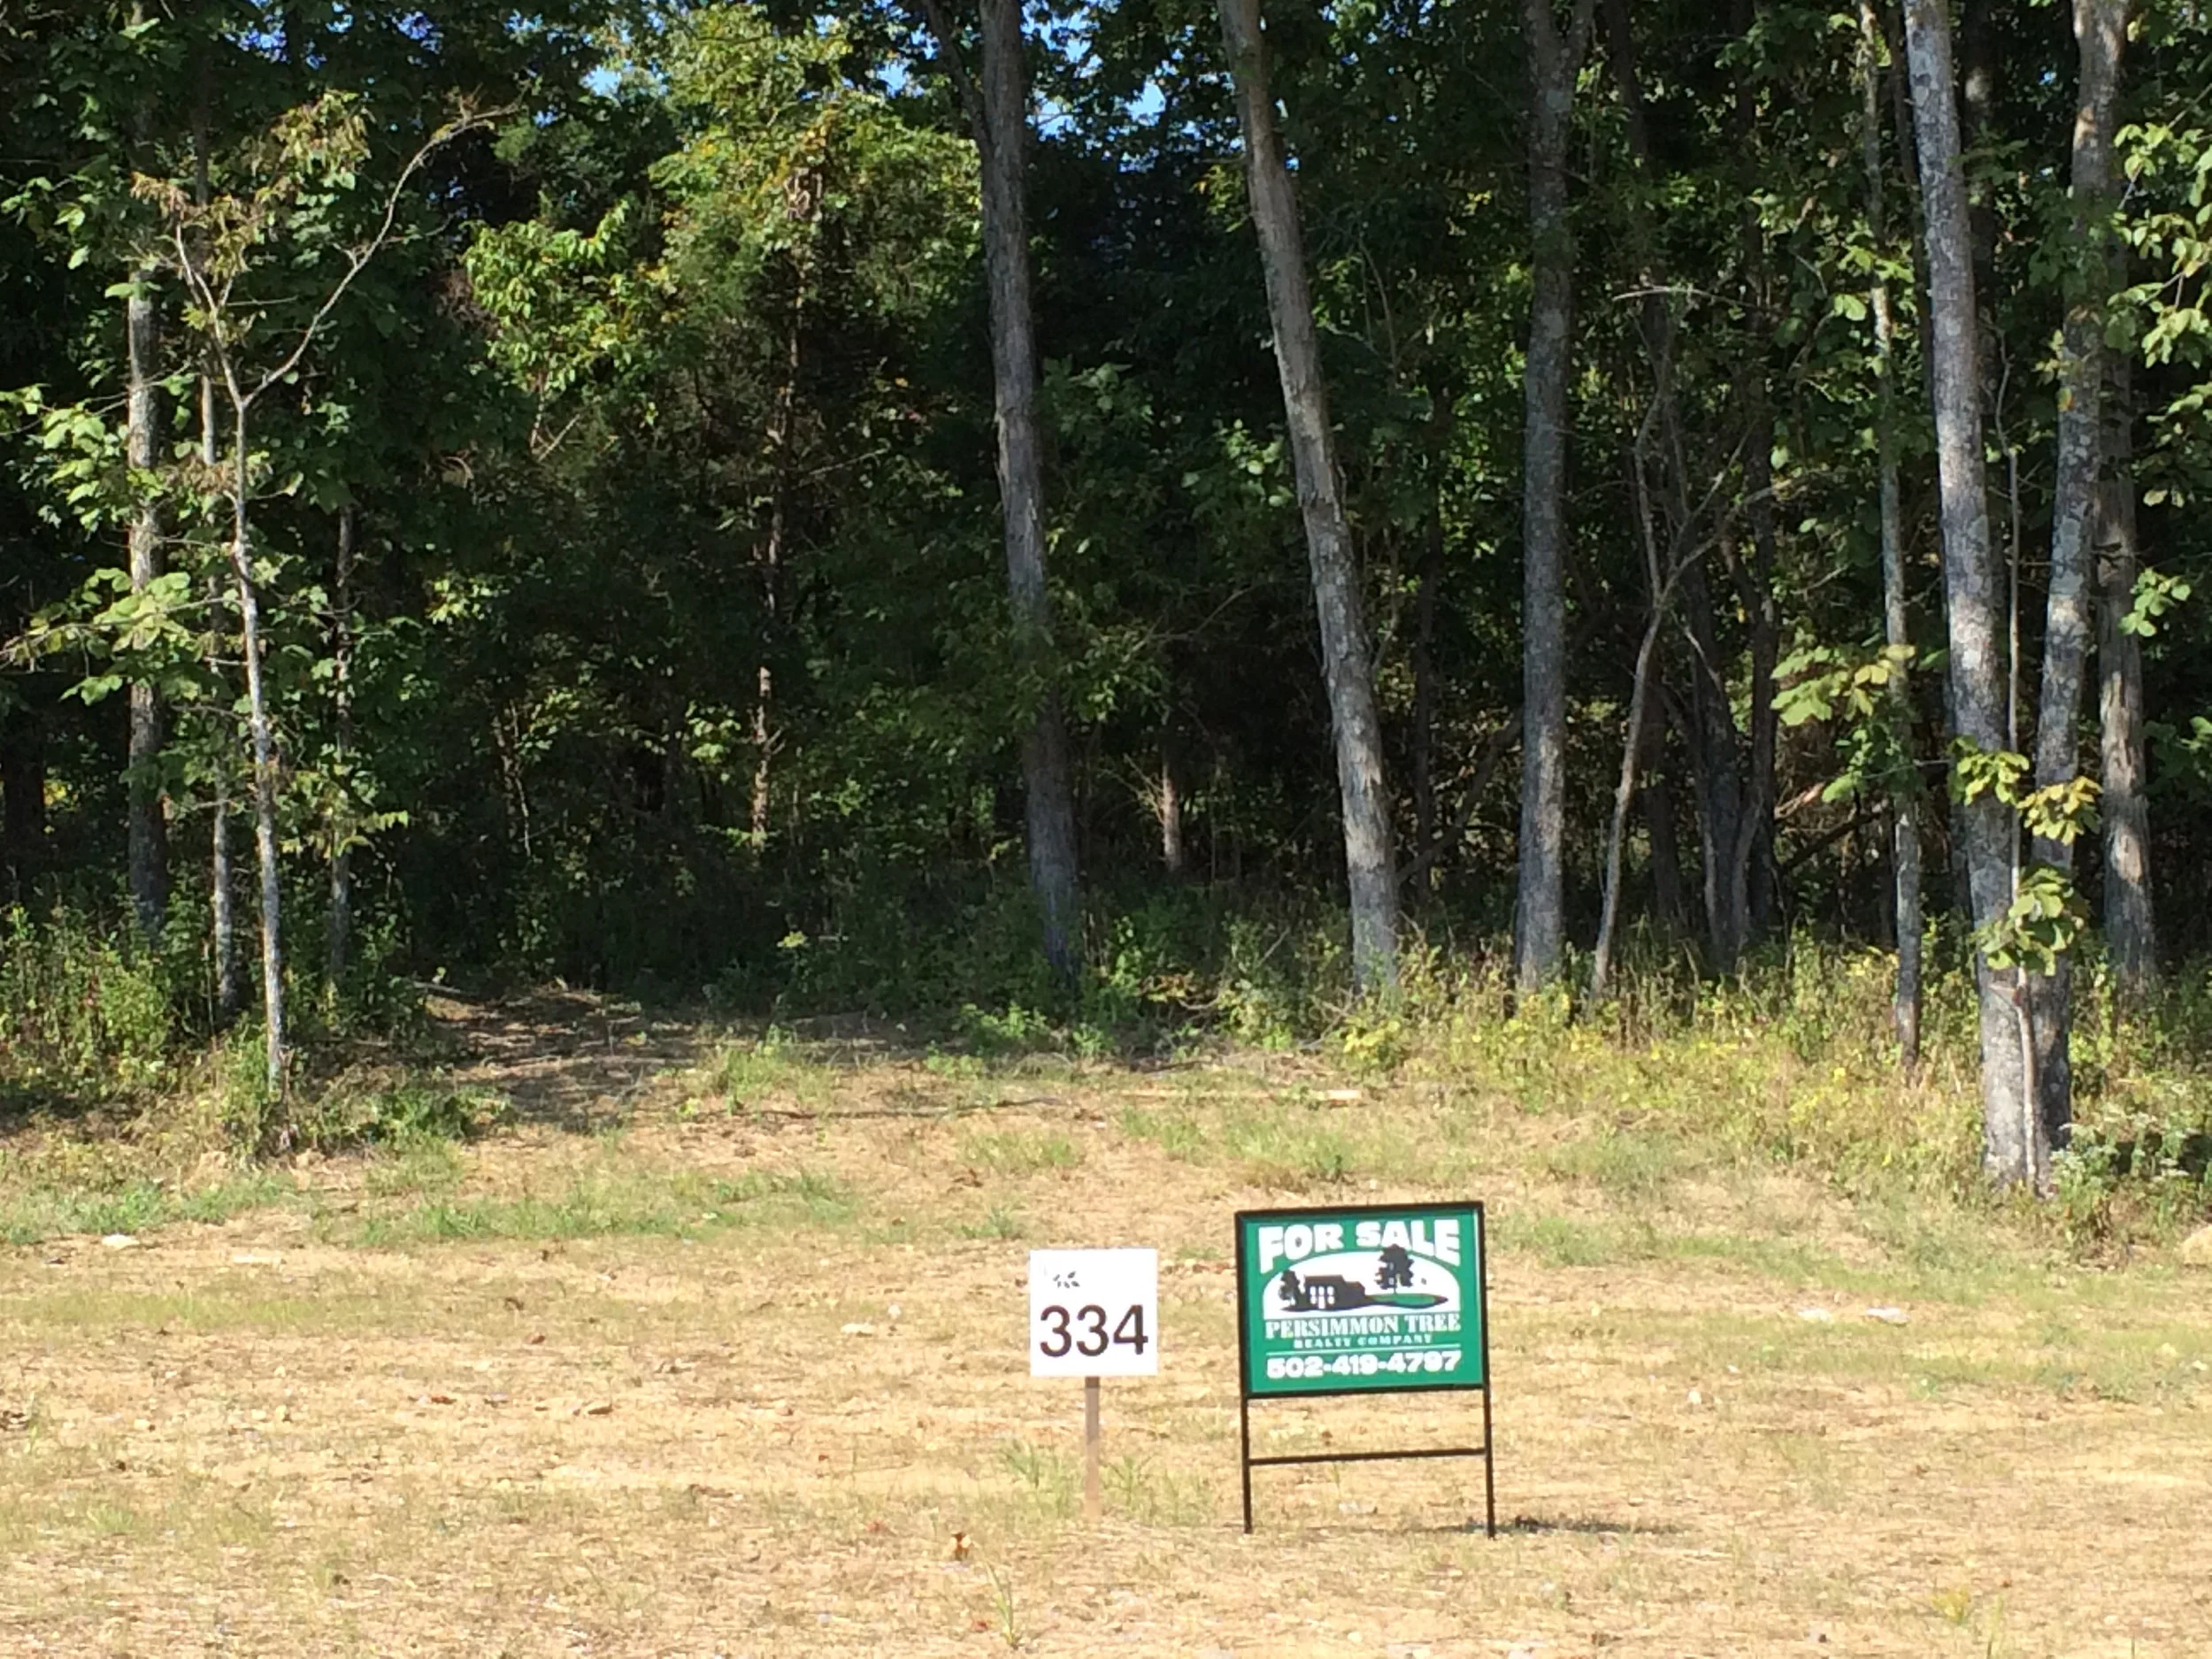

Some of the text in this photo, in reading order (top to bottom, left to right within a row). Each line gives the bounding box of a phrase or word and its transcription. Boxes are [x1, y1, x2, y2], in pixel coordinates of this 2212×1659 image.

[1258, 1219, 1460, 1273] FOR SALE
[1040, 1304, 1148, 1357] 334
[1265, 1314, 1461, 1339] PERSIMMON TREE
[1294, 1334, 1432, 1349] REALTY COMPANY
